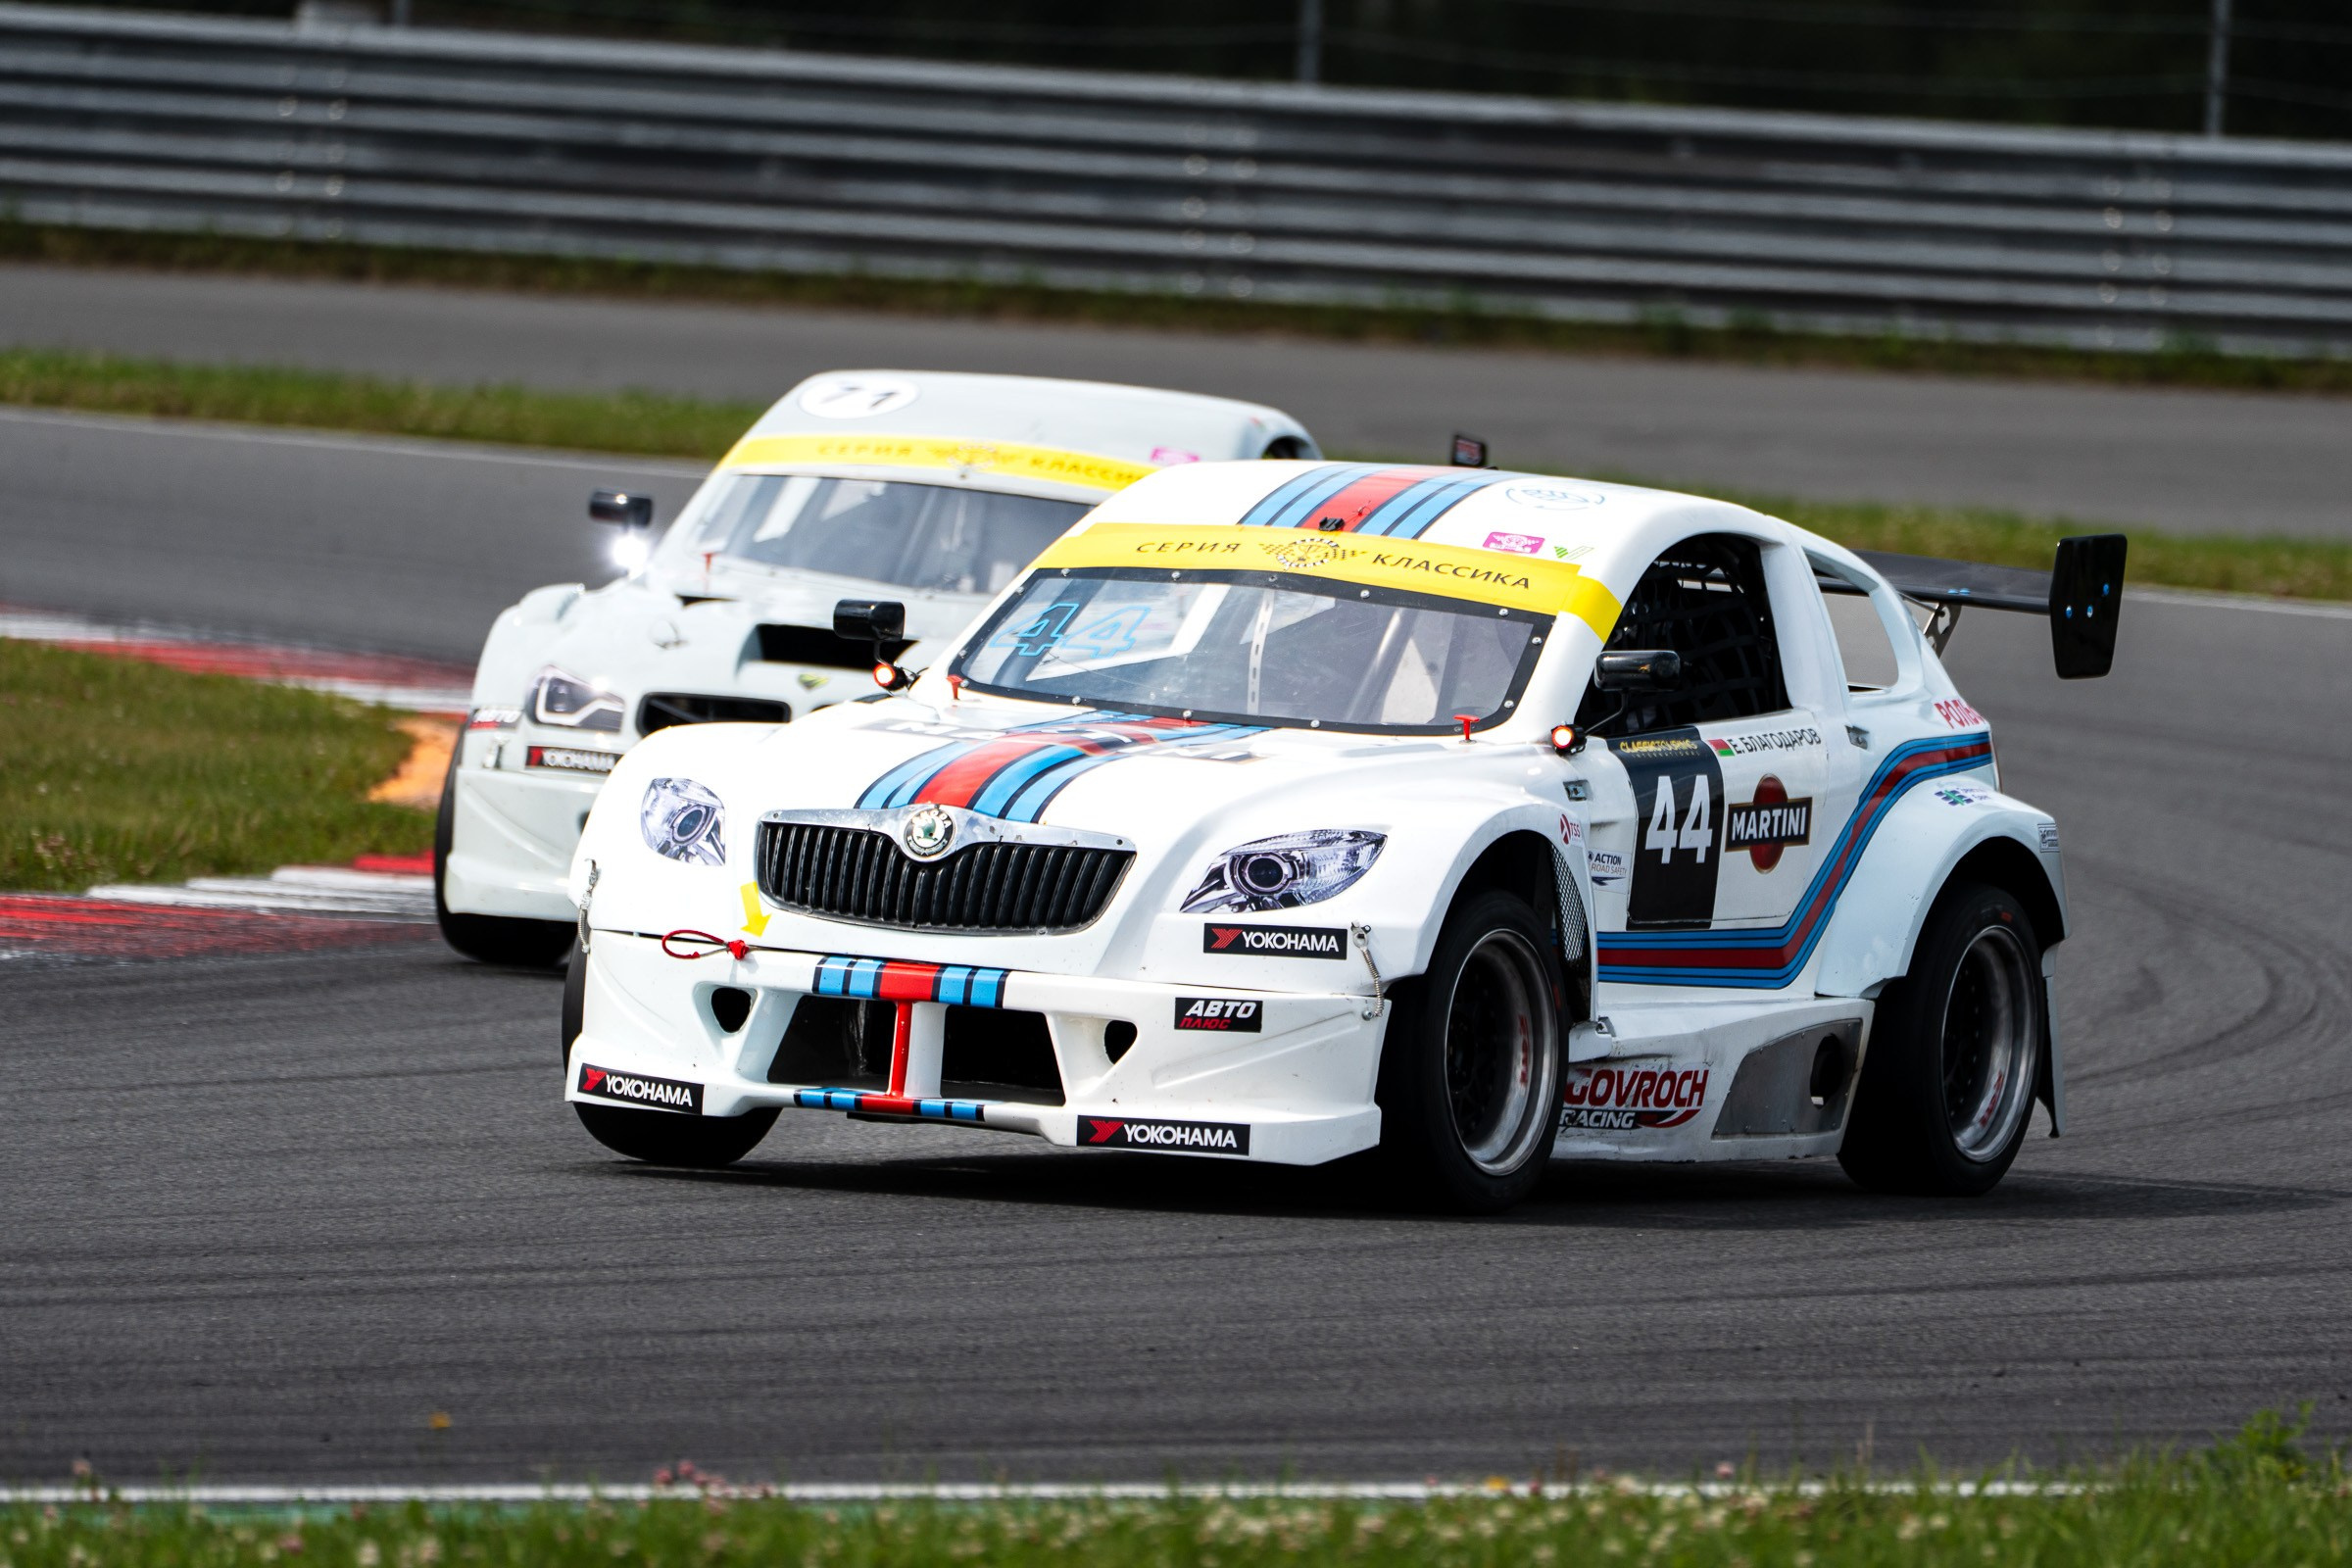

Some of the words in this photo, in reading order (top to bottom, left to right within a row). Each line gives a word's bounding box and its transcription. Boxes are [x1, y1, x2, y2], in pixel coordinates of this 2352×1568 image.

[819, 385, 899, 409] 71
[1030, 458, 1145, 483] КЛАССИ
[1135, 542, 1242, 555] СЕРИЯ
[1372, 553, 1532, 591] КЛАССИКА
[988, 601, 1152, 660] 44
[1570, 822, 1581, 838] TSS
[1645, 774, 1713, 864] 44
[1732, 806, 1809, 841] MARTINI
[1592, 863, 1610, 874] ROAD
[1611, 866, 1627, 876] SAFETY
[1594, 853, 1622, 866] ACTION
[1243, 931, 1340, 953] YOKOHAMA
[1185, 1000, 1257, 1019] АВТО
[606, 1074, 693, 1108] YOKOHAMA
[1559, 1109, 1636, 1128] RACING
[1124, 1124, 1238, 1149] YOKOHAMA
